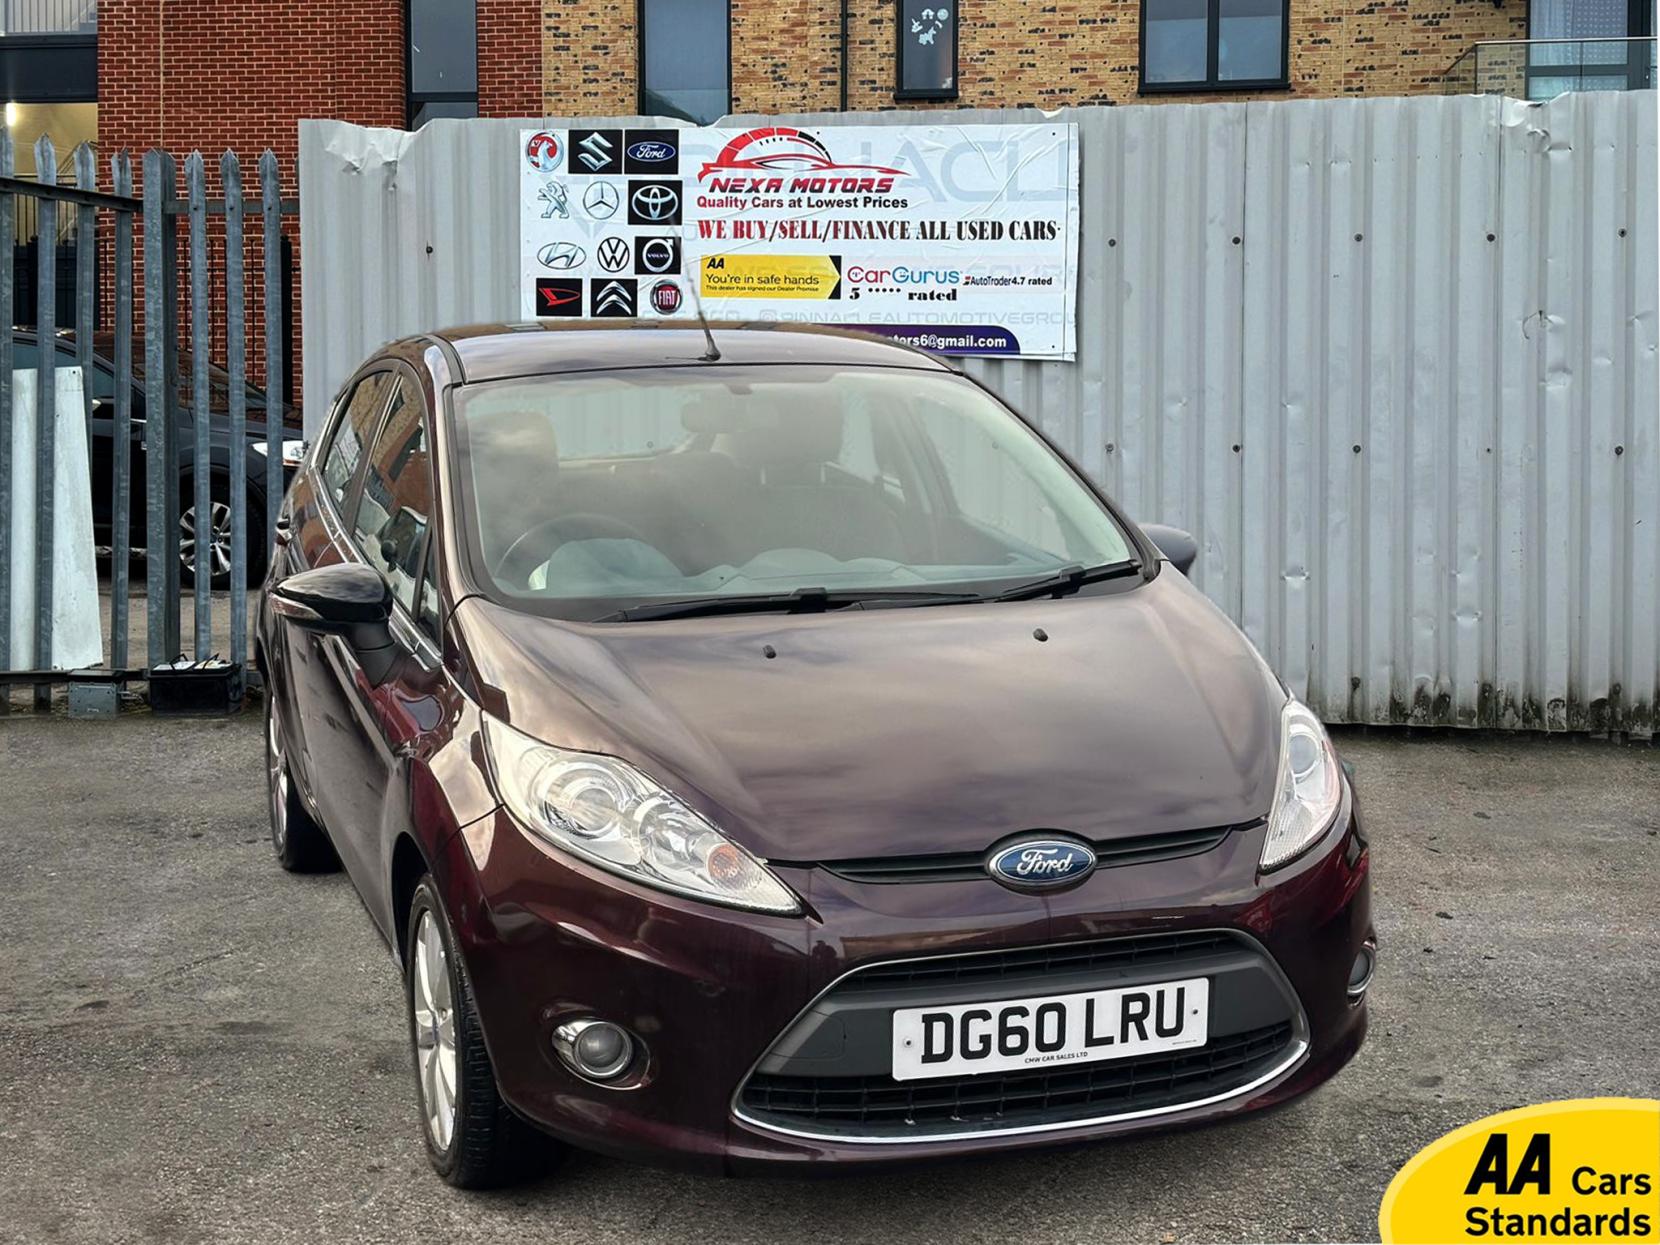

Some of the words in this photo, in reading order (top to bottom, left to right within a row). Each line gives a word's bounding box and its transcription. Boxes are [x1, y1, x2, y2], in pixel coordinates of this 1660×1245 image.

[636, 144, 666, 159] Ford
[709, 178, 783, 194] NEXA
[789, 177, 894, 194] MOTORS
[697, 196, 746, 210] Quality
[750, 196, 784, 208] Cars
[788, 197, 803, 208] at
[807, 196, 862, 208] Lowest
[866, 196, 908, 208] Prices
[697, 220, 727, 240] WE
[733, 219, 911, 242] BUY/SELL/FINANCE
[915, 220, 953, 240] ALL
[956, 220, 1003, 240] USED
[1008, 220, 1057, 240] CARS
[706, 257, 725, 269] AA
[705, 274, 741, 284] You're
[744, 274, 754, 284] in
[757, 274, 781, 284] safe
[784, 274, 820, 285] hands
[847, 266, 960, 284] CarGurus
[1011, 276, 1026, 285] 4.7
[1027, 275, 1053, 286] rated
[658, 290, 676, 305] FIAT
[849, 287, 861, 300] 5
[908, 288, 958, 301] rated
[1016, 848, 1074, 875] Ford
[921, 1001, 1067, 1065] DG60
[1084, 987, 1186, 1048] LRU
[1024, 1056, 1041, 1064] CMW
[1042, 1055, 1055, 1063] CAR
[1056, 1052, 1076, 1061] SALES
[1076, 1051, 1089, 1059] LTD
